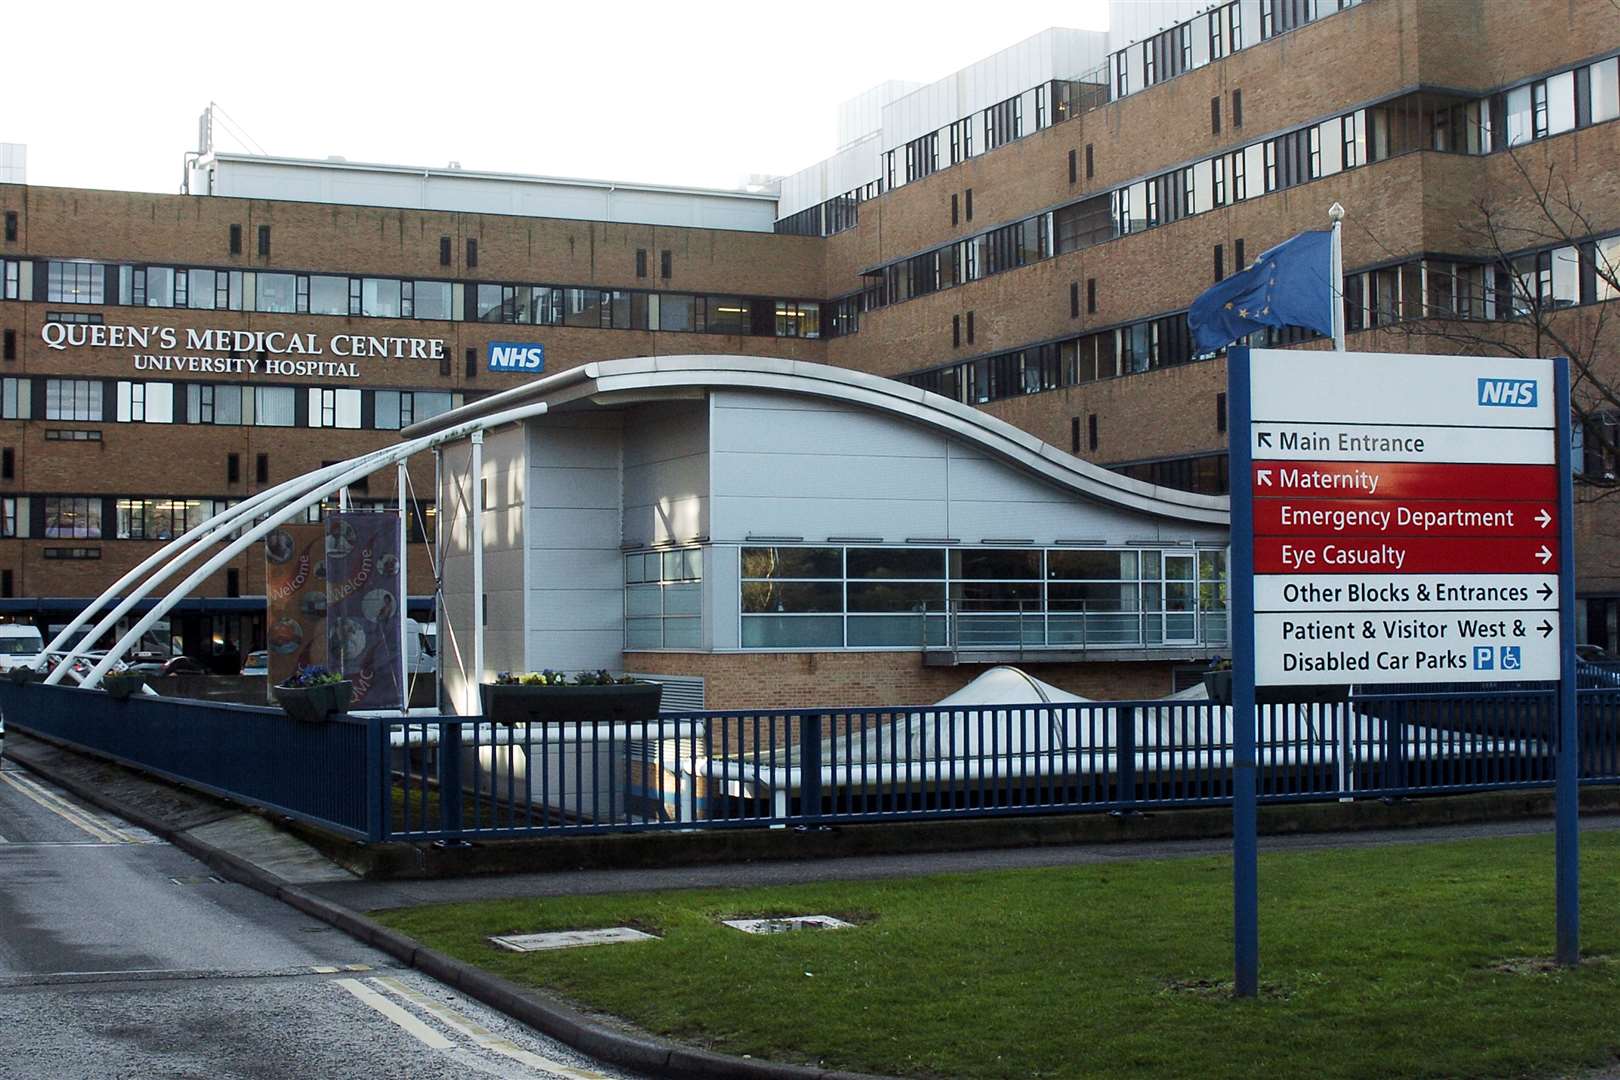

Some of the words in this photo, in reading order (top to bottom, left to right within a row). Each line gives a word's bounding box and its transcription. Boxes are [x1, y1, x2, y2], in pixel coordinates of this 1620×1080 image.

[41, 322, 177, 350] QUEEN'S
[185, 328, 323, 355] MEDICAL
[330, 334, 445, 360] CENTRE
[134, 354, 259, 374] UNIVERSITY
[265, 359, 360, 377] HOSPITAL
[490, 346, 541, 369] NHS
[1480, 380, 1534, 405] NHS
[1279, 431, 1330, 451] Main
[1338, 433, 1425, 452] Entrance
[1279, 468, 1379, 494] Maternity
[1281, 506, 1391, 531] Emergency
[1397, 507, 1514, 530] Department
[1282, 545, 1316, 568] Eye
[1322, 544, 1406, 568] Casualty
[269, 554, 310, 602] Welcome
[329, 548, 373, 604] Welcome
[1283, 583, 1342, 602] Other
[1348, 583, 1410, 603] Blocks
[1416, 583, 1430, 601] &
[1436, 583, 1528, 602] Entrances
[1282, 620, 1355, 640] Patient
[1362, 621, 1376, 639] &
[1383, 620, 1448, 638] Visitor
[1457, 619, 1506, 638] West
[1512, 619, 1526, 637] &
[1283, 650, 1369, 672] Disabled
[1376, 651, 1410, 670] Car
[1415, 649, 1467, 670] Parks
[1476, 647, 1492, 669] P
